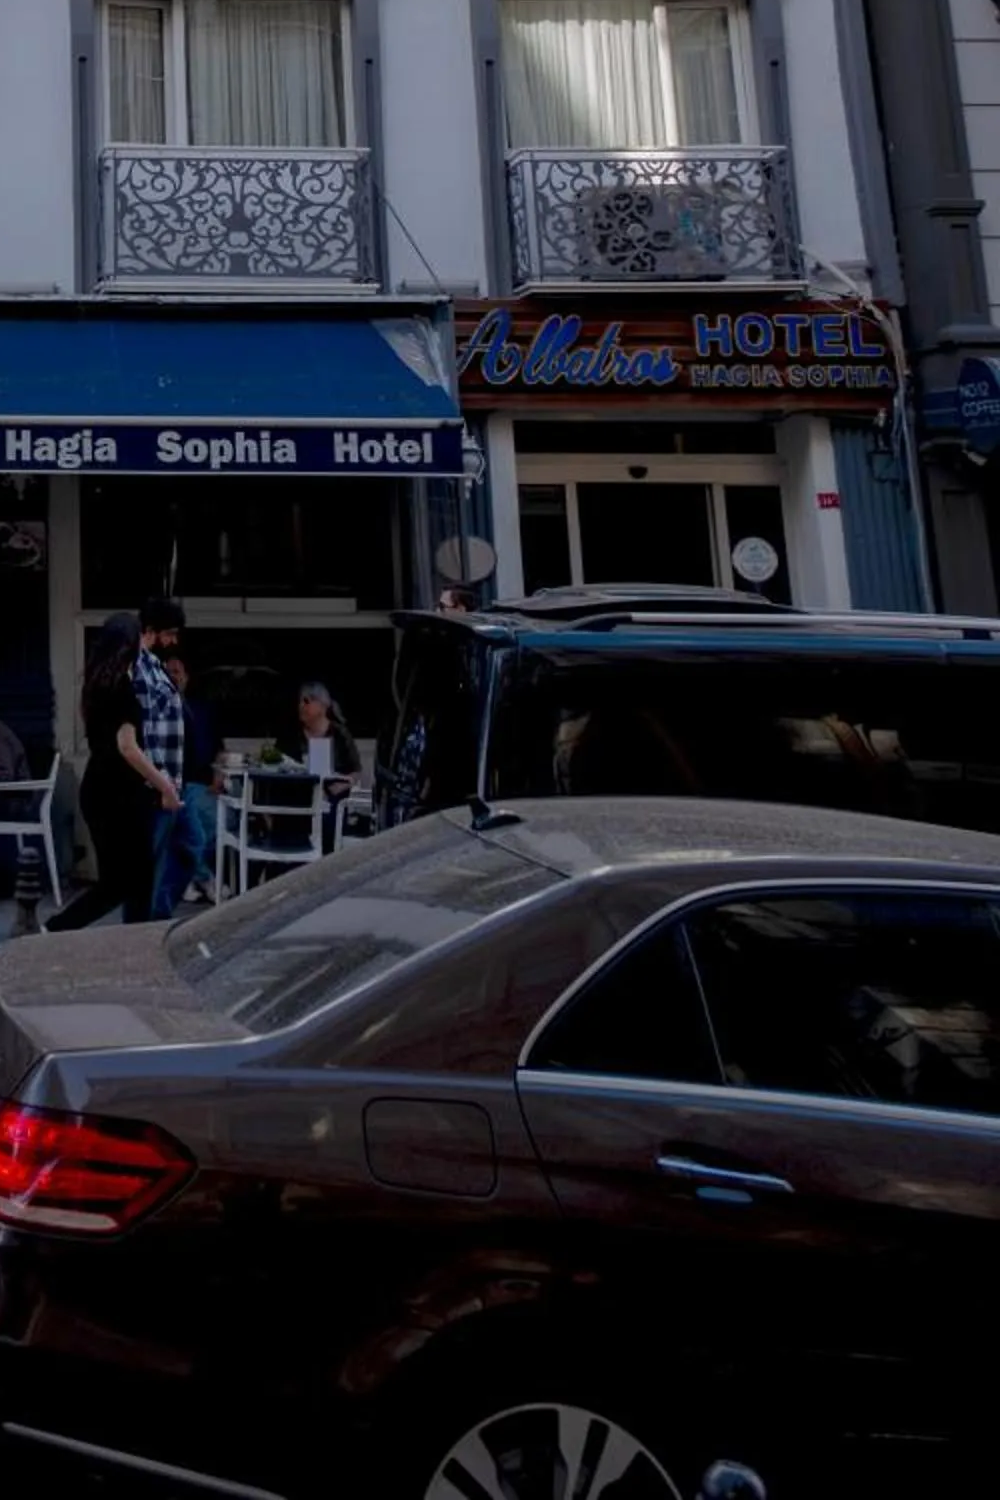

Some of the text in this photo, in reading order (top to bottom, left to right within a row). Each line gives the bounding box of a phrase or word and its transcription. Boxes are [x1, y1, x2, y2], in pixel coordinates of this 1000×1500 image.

[457, 307, 886, 387] Albatros HOTEL
[690, 364, 896, 389] HAGIA SOPHIA
[5, 429, 118, 469] Hagia
[156, 430, 298, 469] Sophia
[333, 432, 434, 463] Hotel
